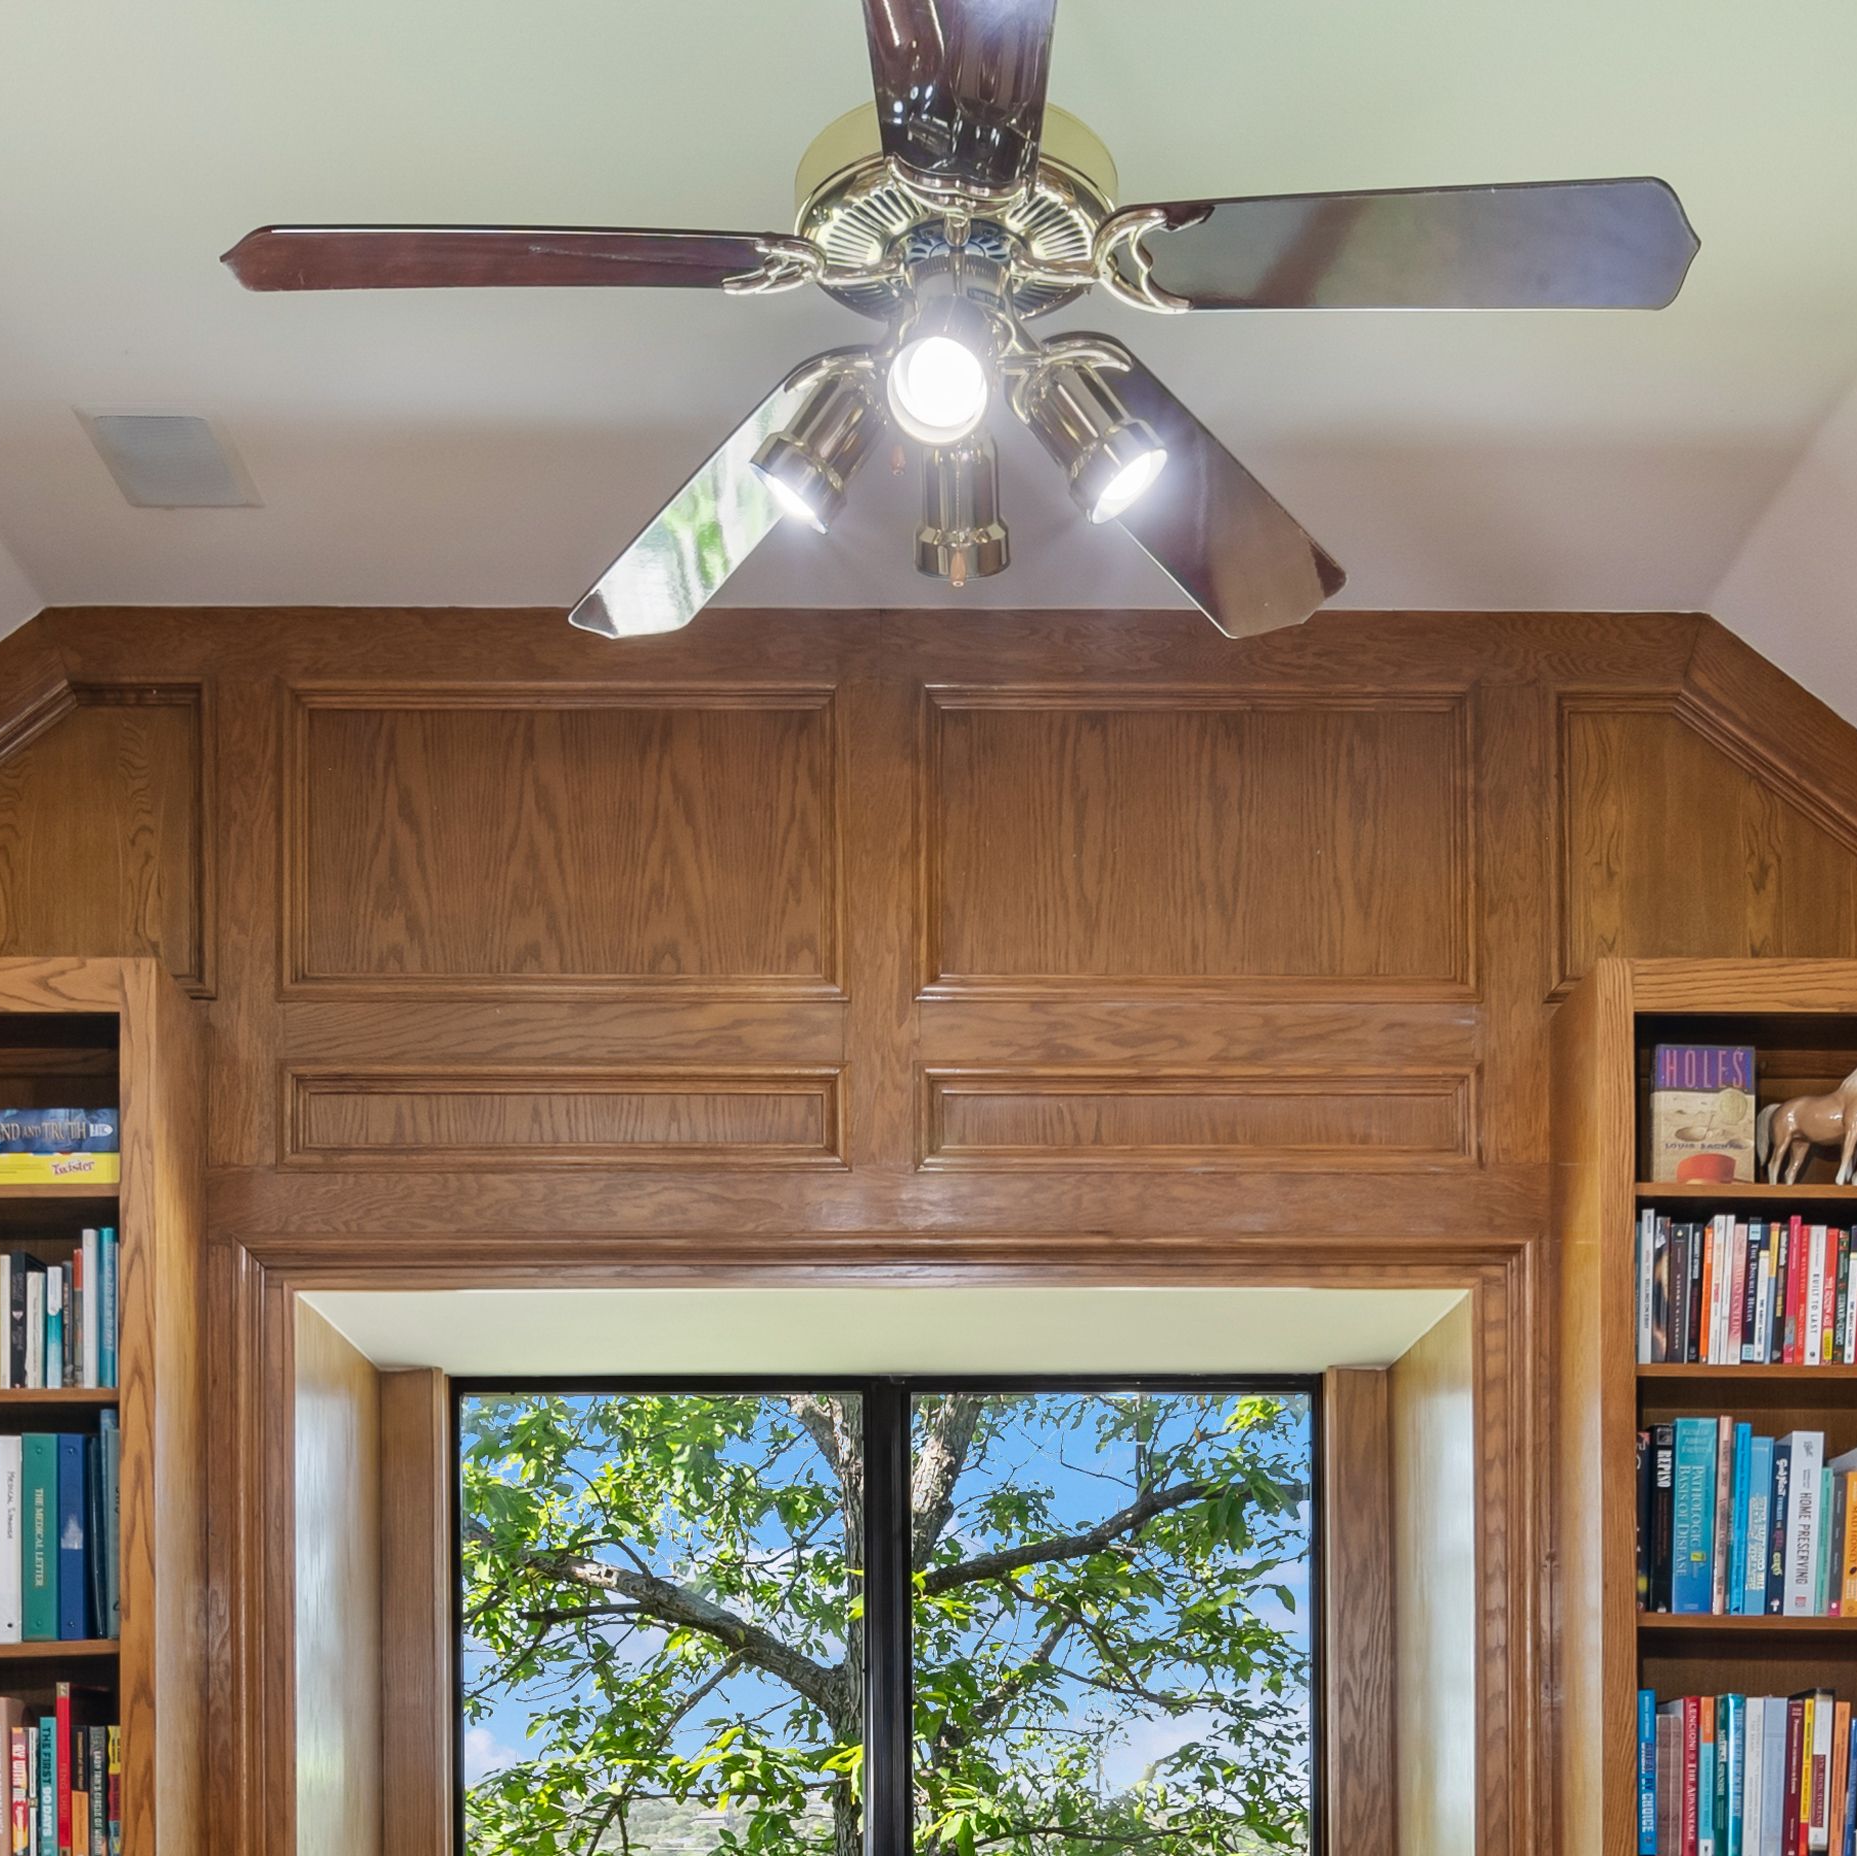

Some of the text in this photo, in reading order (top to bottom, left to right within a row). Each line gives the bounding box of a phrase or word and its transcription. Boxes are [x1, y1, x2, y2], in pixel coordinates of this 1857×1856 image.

[1666, 1049, 1744, 1088] HOLES
[42, 1121, 87, 1141] TRUTH
[51, 1160, 95, 1177] Twister
[1749, 1243, 1758, 1259] THE
[1747, 1295, 1756, 1322] HELIX
[1810, 1274, 1820, 1333] BUILT TO LAST
[35, 1488, 44, 1586] THE MEDICAL LETTER
[1676, 1466, 1690, 1577] BASIS OF DISEASE
[1690, 1465, 1705, 1547] PATHOLOGIC
[1795, 1492, 1812, 1585] HOME PRESERVING
[42, 1727, 53, 1837] THE FIRST 90 DAYS
[1687, 1702, 1697, 1840] LENCIONI THE ADVANTAGE
